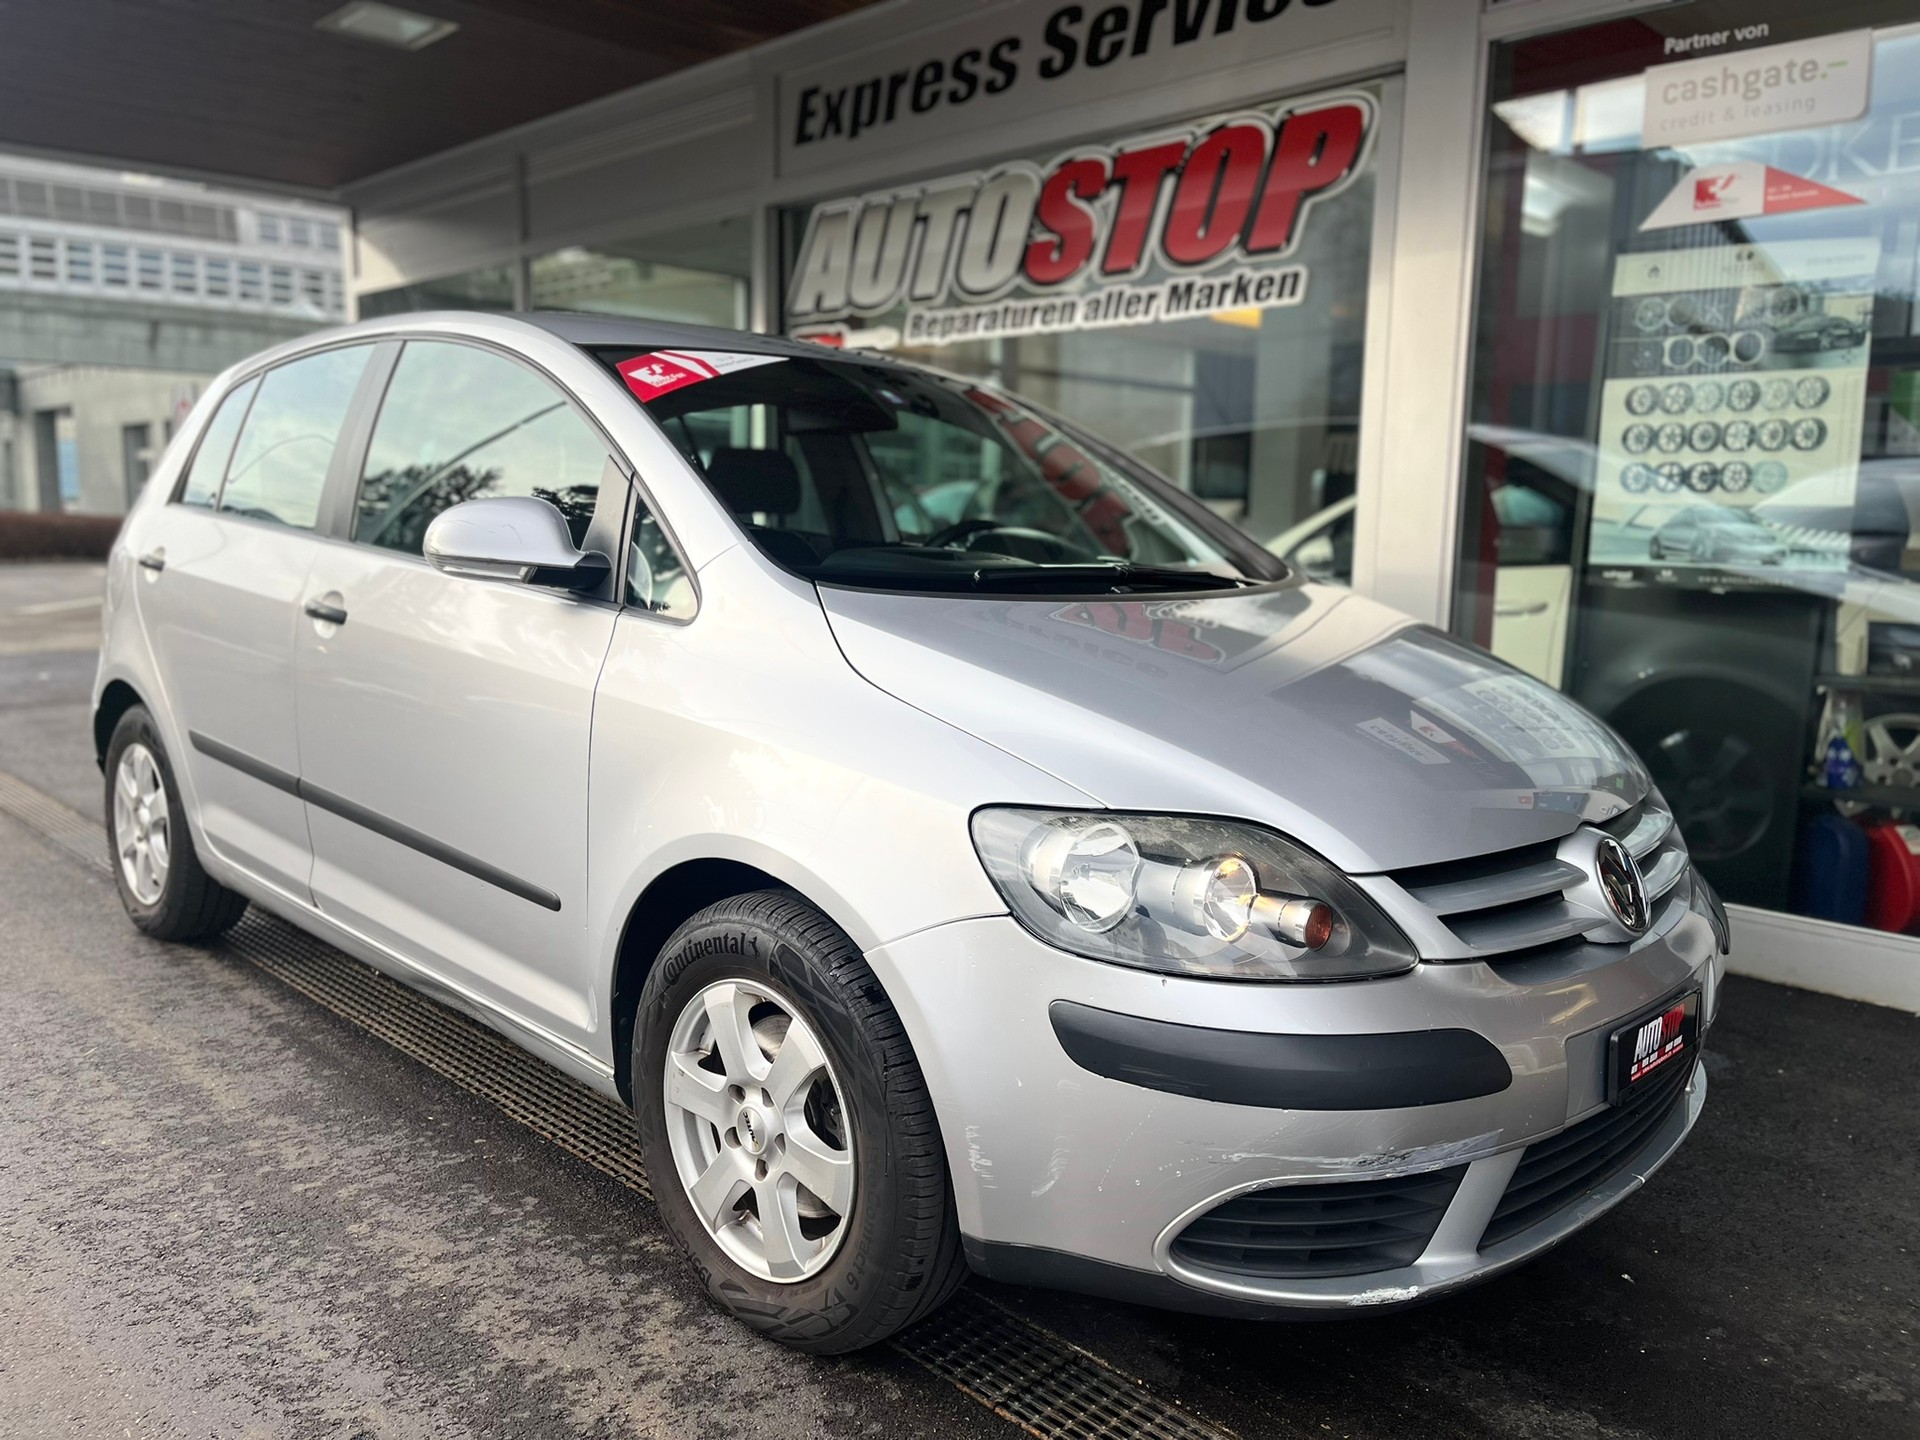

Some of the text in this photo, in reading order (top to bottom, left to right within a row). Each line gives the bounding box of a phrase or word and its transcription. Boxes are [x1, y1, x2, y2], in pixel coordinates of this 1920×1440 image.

[1664, 23, 1770, 55] Partner von
[794, 0, 1338, 146] Express Servi
[1660, 96, 1817, 132] credit & leasing
[909, 268, 1303, 340] Reparaturen aller Marken
[663, 931, 746, 986] Continental
[742, 1111, 758, 1144] AUTEC
